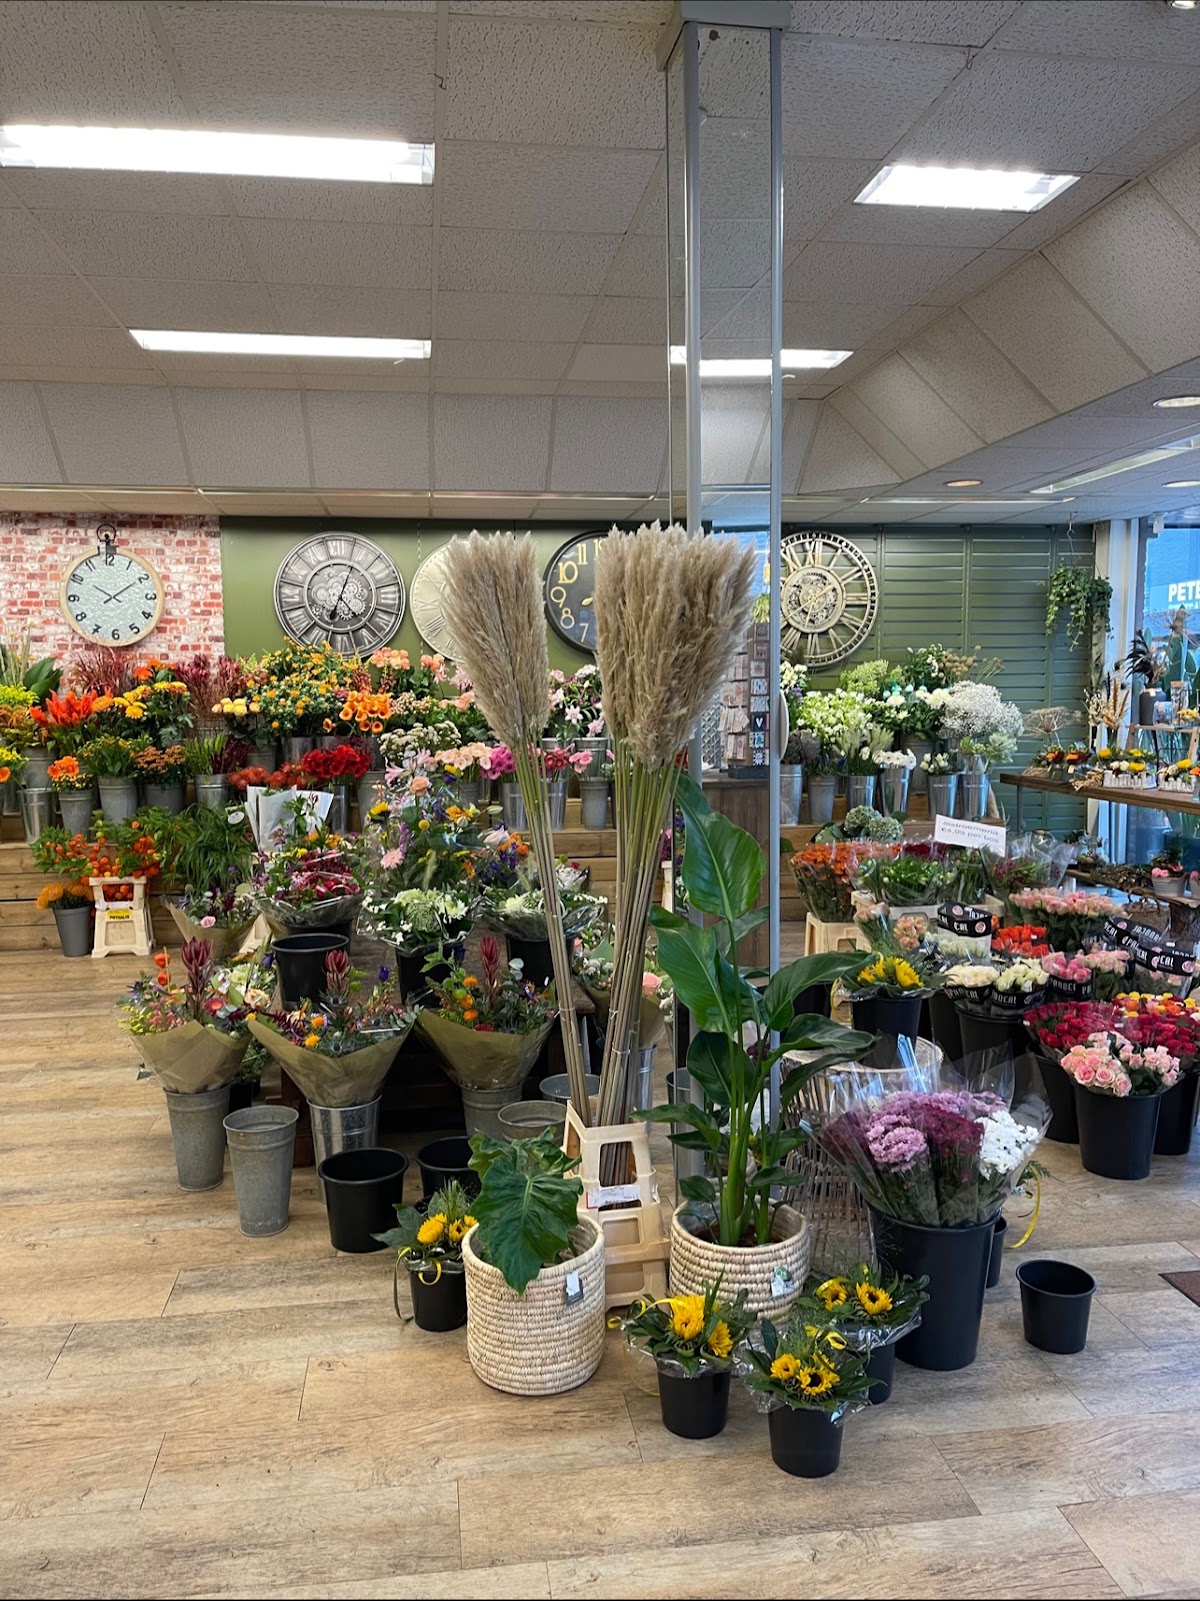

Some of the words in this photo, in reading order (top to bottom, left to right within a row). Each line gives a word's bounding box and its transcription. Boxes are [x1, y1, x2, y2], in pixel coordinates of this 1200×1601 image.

[106, 554, 115, 566] 12
[577, 543, 588, 565] 11
[85, 559, 96, 572] 11
[126, 560, 133, 571] 1
[558, 560, 578, 584] 10
[71, 573, 84, 586] 10
[138, 573, 150, 585] 2
[68, 594, 80, 603] 9
[145, 592, 157, 601] 3
[550, 586, 567, 608] 9
[75, 611, 87, 622] 8
[141, 610, 153, 620] 4
[560, 607, 575, 630] 8
[91, 623, 102, 635] 7
[111, 628, 120, 641] 6
[129, 623, 140, 635] 5
[580, 622, 589, 643] 7
